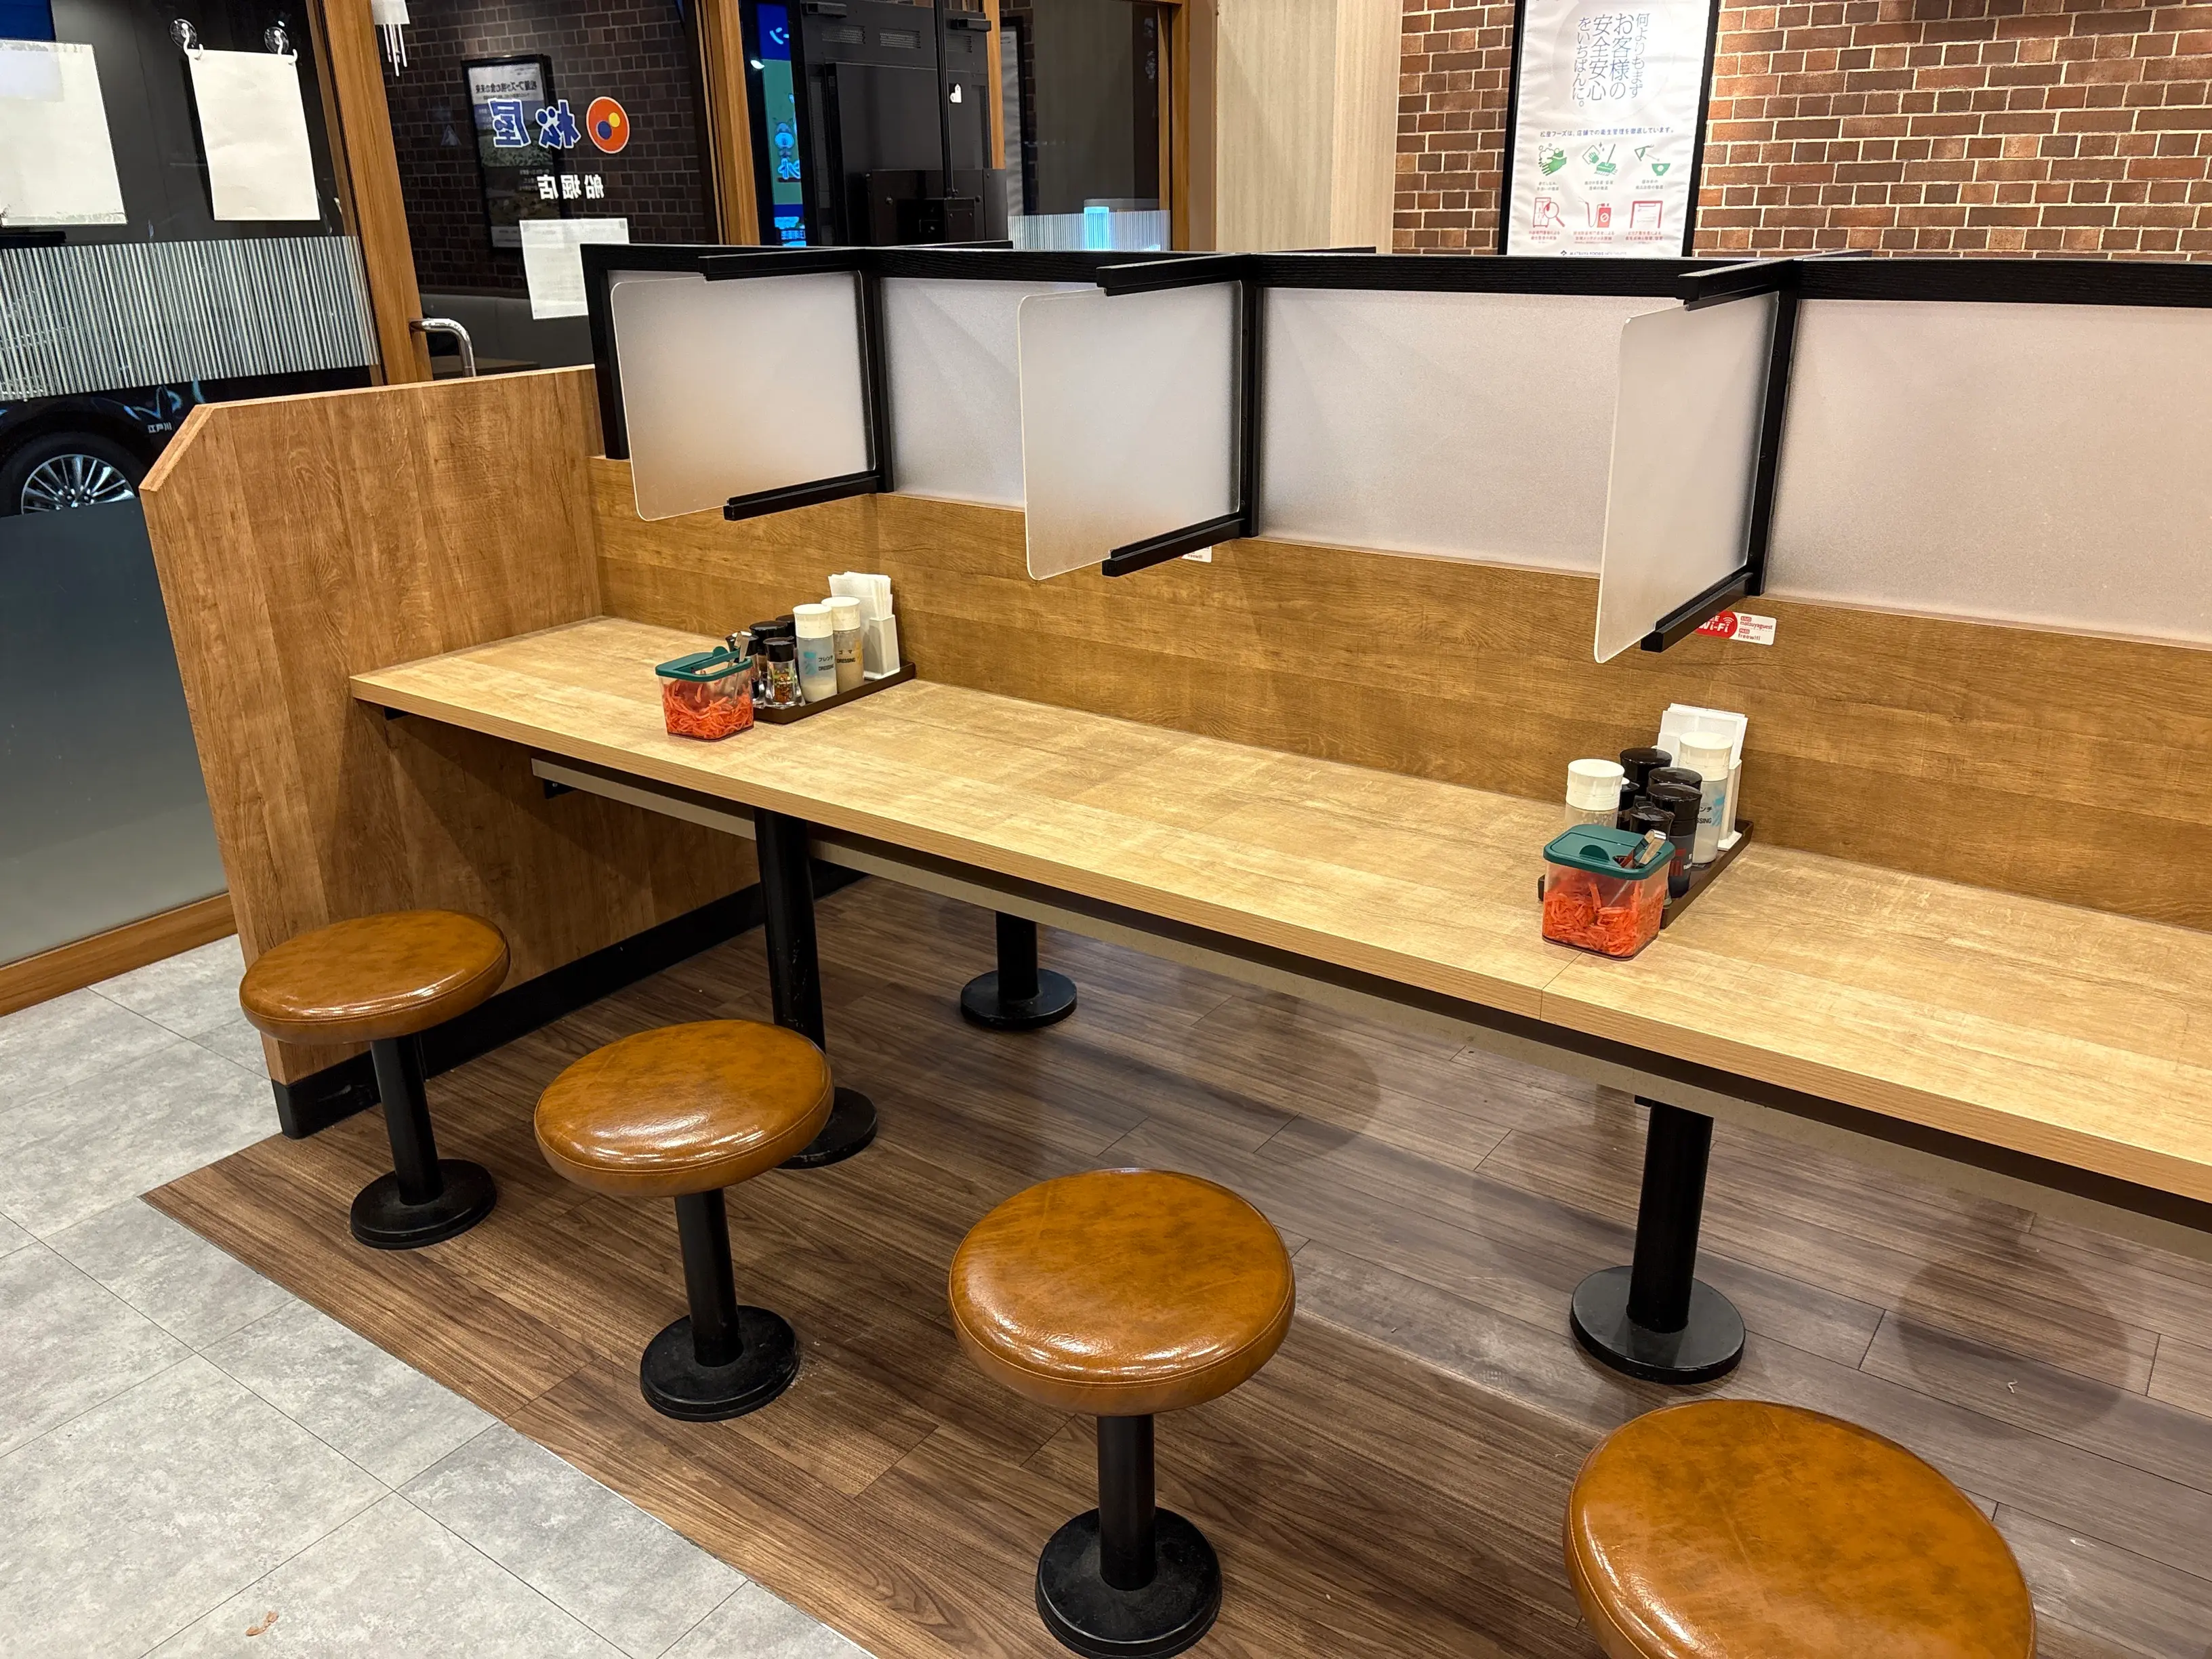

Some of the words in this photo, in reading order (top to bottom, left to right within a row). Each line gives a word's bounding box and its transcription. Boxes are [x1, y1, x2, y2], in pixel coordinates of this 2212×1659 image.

[1572, 17, 1591, 108] をいちばんに。
[1586, 14, 1613, 101] 安全安心
[1609, 12, 1635, 100] お客様の
[1629, 12, 1651, 99] 何よりもまず
[148, 422, 173, 434] 江戸川
